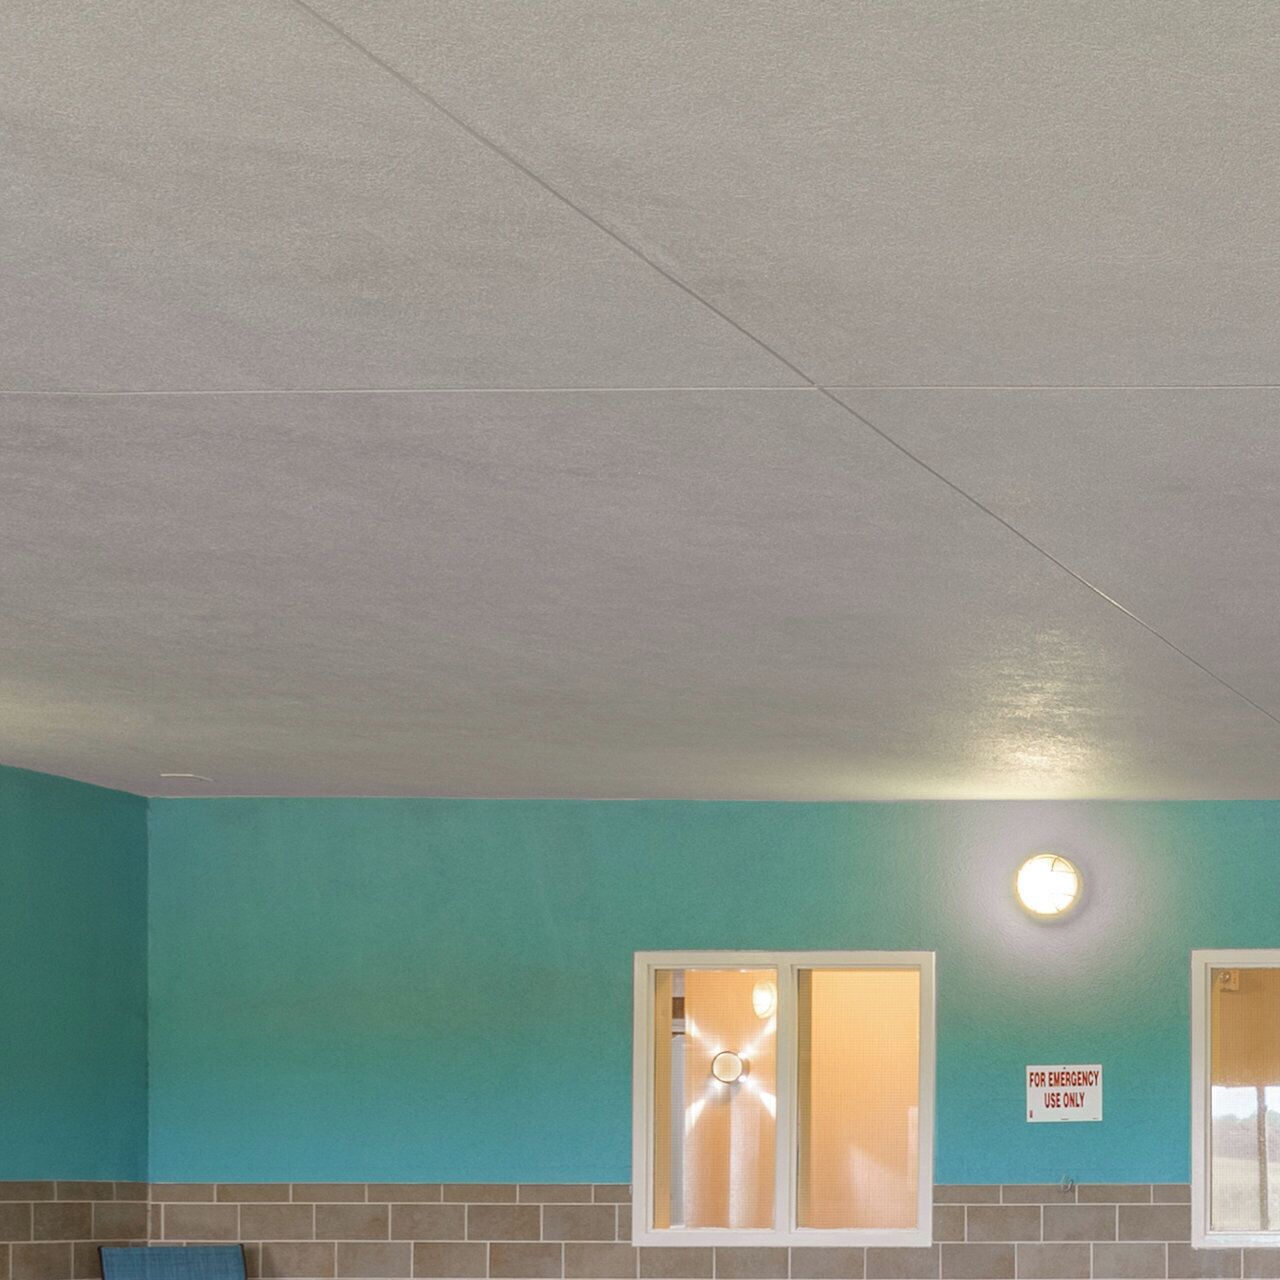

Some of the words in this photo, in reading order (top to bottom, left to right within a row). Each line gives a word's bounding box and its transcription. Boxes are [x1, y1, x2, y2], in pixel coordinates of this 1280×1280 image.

[1029, 1071, 1046, 1088] FOR
[1048, 1070, 1100, 1087] EMERGENCY
[1044, 1092, 1061, 1108] USE
[1063, 1091, 1085, 1108] ONLY
